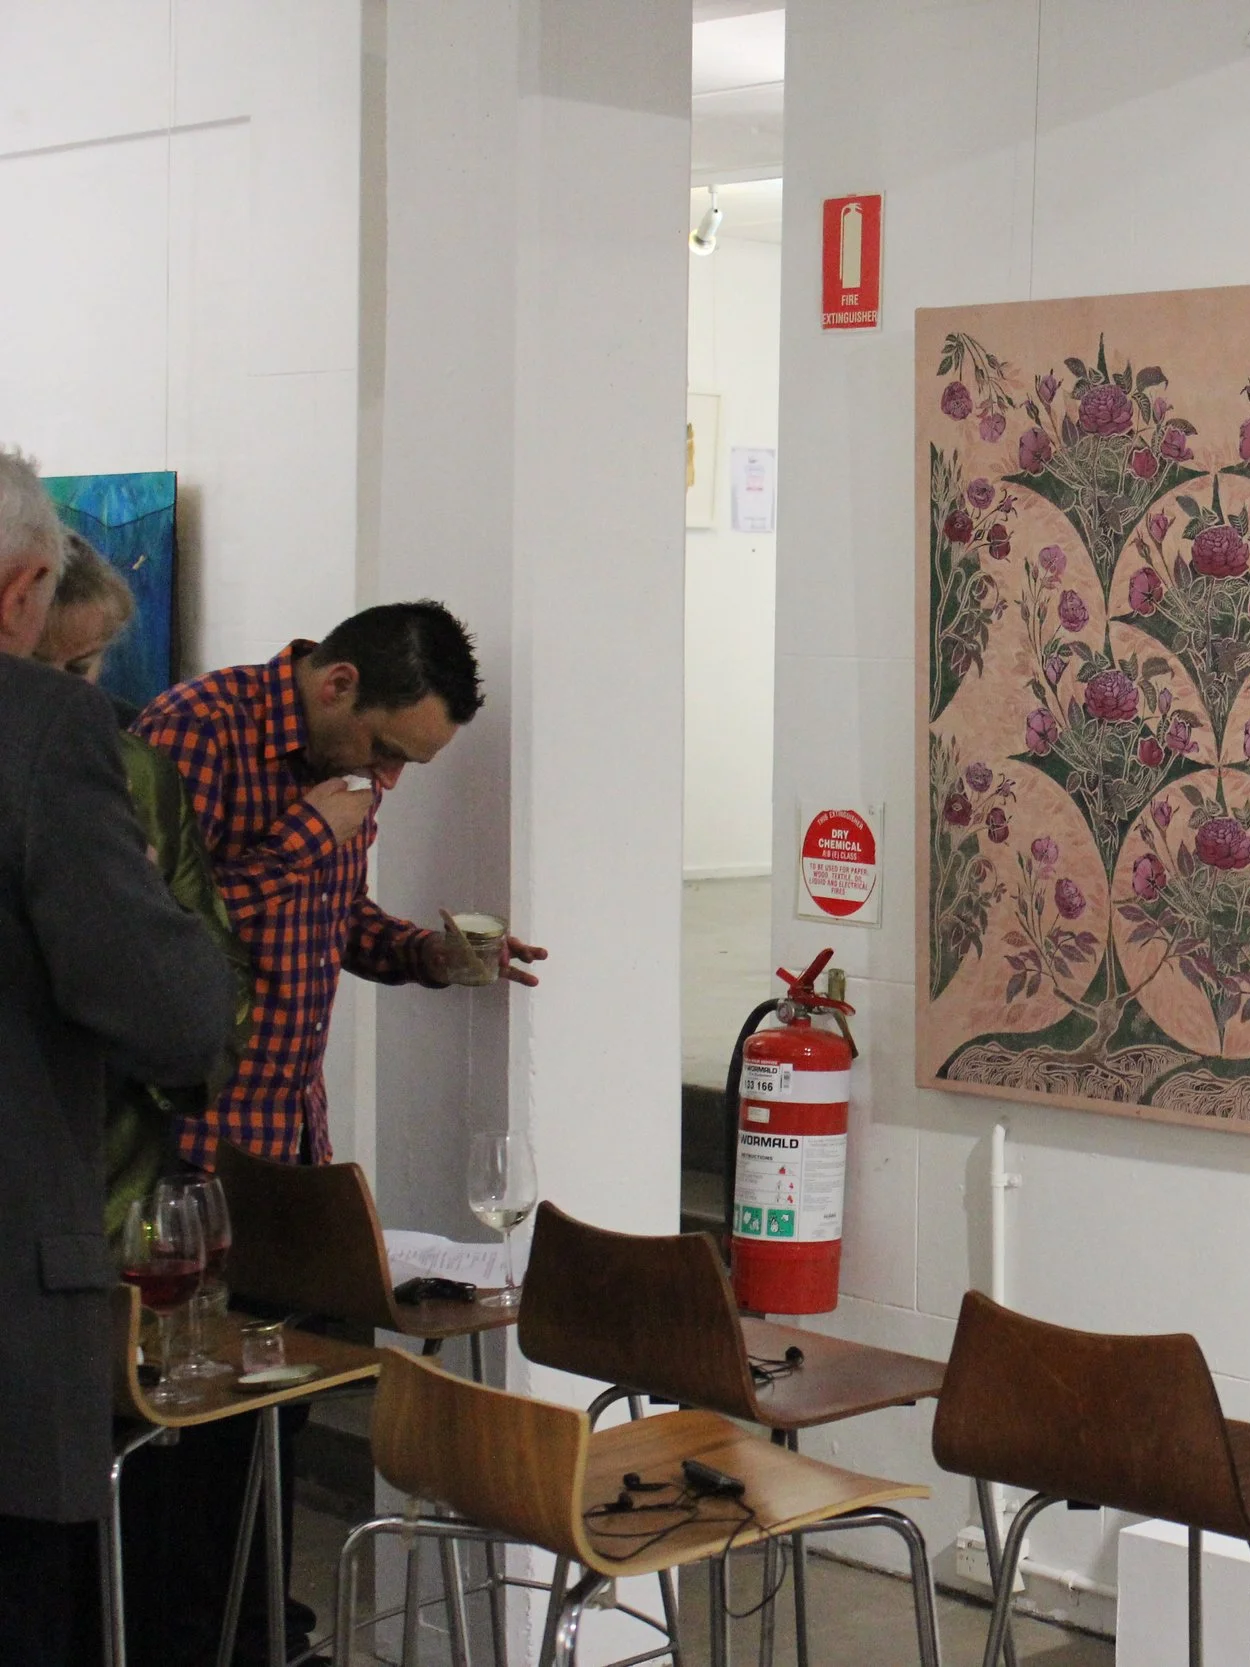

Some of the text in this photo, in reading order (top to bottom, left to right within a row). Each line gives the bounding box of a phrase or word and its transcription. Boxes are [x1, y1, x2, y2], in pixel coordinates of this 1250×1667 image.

[841, 294, 859, 306] FIRE
[823, 311, 877, 324] EXTINGUISHER
[832, 829, 849, 840] DRY
[819, 839, 861, 852] CHEMICAL
[840, 852, 857, 860] CLASS
[817, 863, 824, 871] BE
[827, 879, 838, 887] AND
[839, 882, 868, 890] ELECTRICAL
[757, 1081, 774, 1092] 166
[741, 1135, 799, 1149] WORMALD
